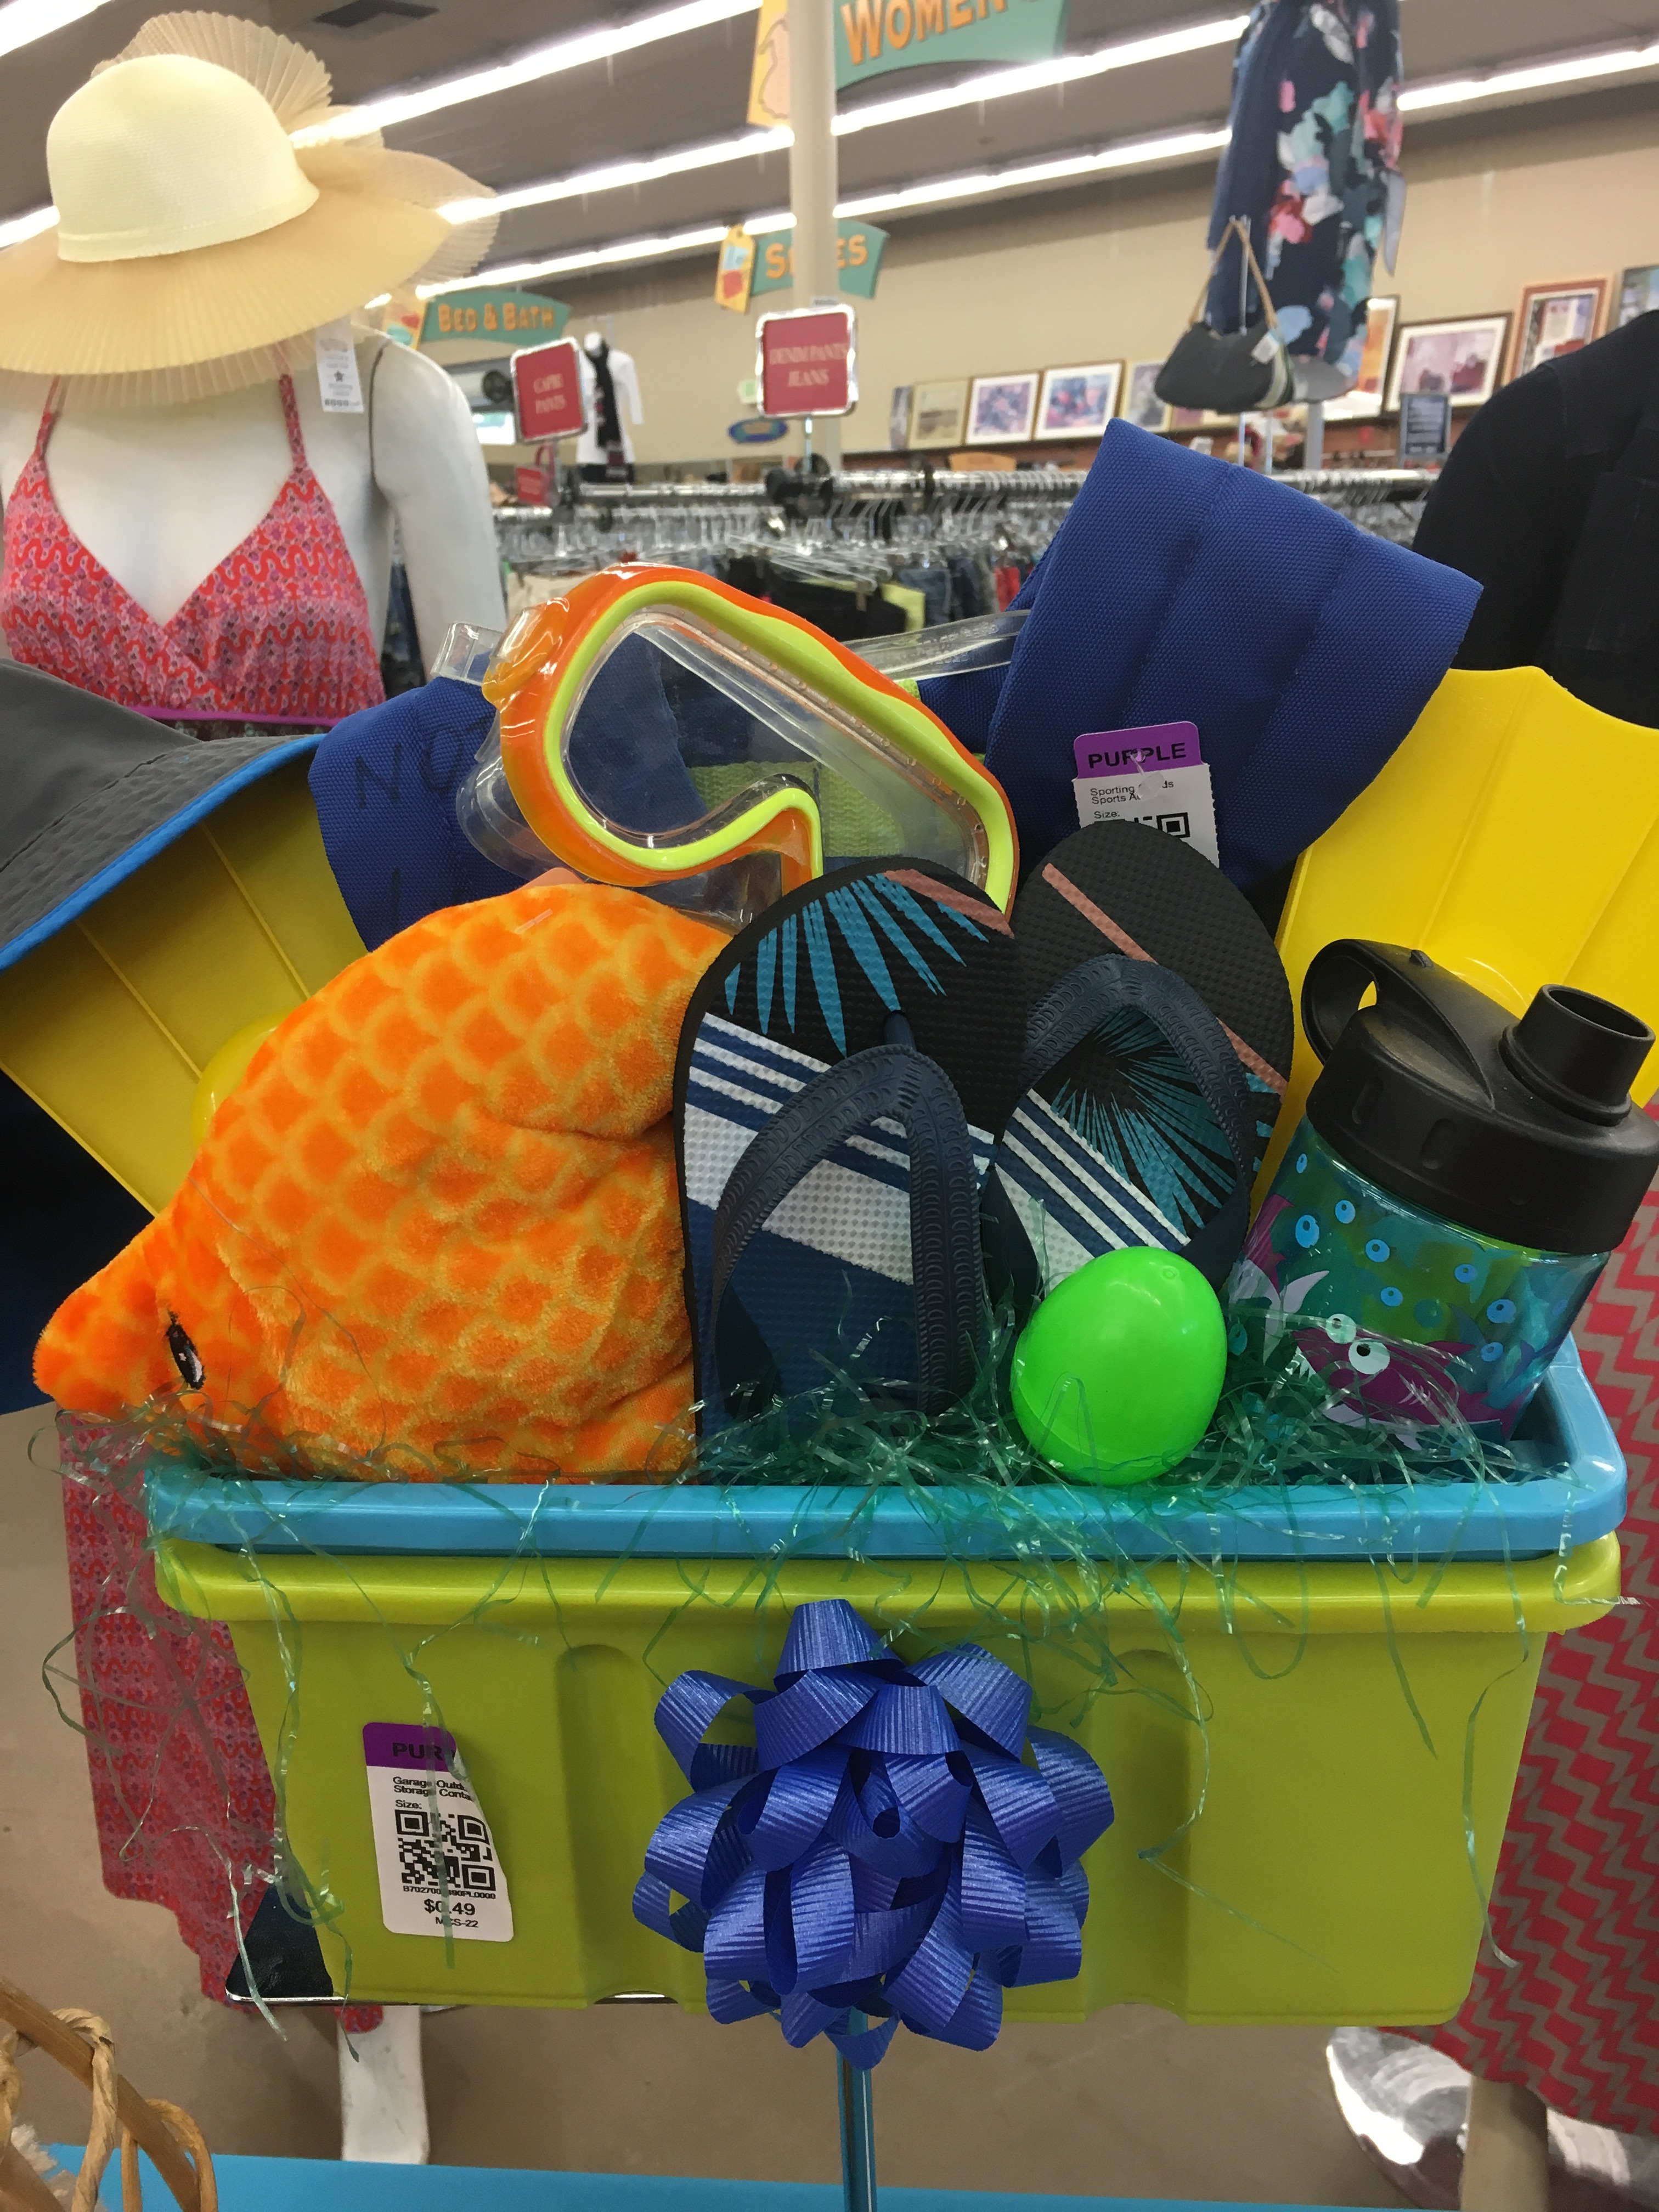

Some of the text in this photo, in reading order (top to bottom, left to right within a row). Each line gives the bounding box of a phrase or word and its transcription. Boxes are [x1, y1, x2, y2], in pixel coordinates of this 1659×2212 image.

[765, 234, 868, 279] SES
[438, 304, 477, 332] BED
[503, 302, 554, 331] BATH
[1088, 742, 1187, 769] PURPLE
[1090, 786, 1135, 797] Sporting
[1091, 794, 1127, 805] Sports
[1094, 810, 1120, 819] Size:
[392, 1742, 456, 1761] PUR
[394, 1785, 436, 1797] Storag
[395, 1799, 422, 1809] Size:
[424, 1898, 476, 1916] $0.49
[435, 1917, 479, 1928] MS-22
